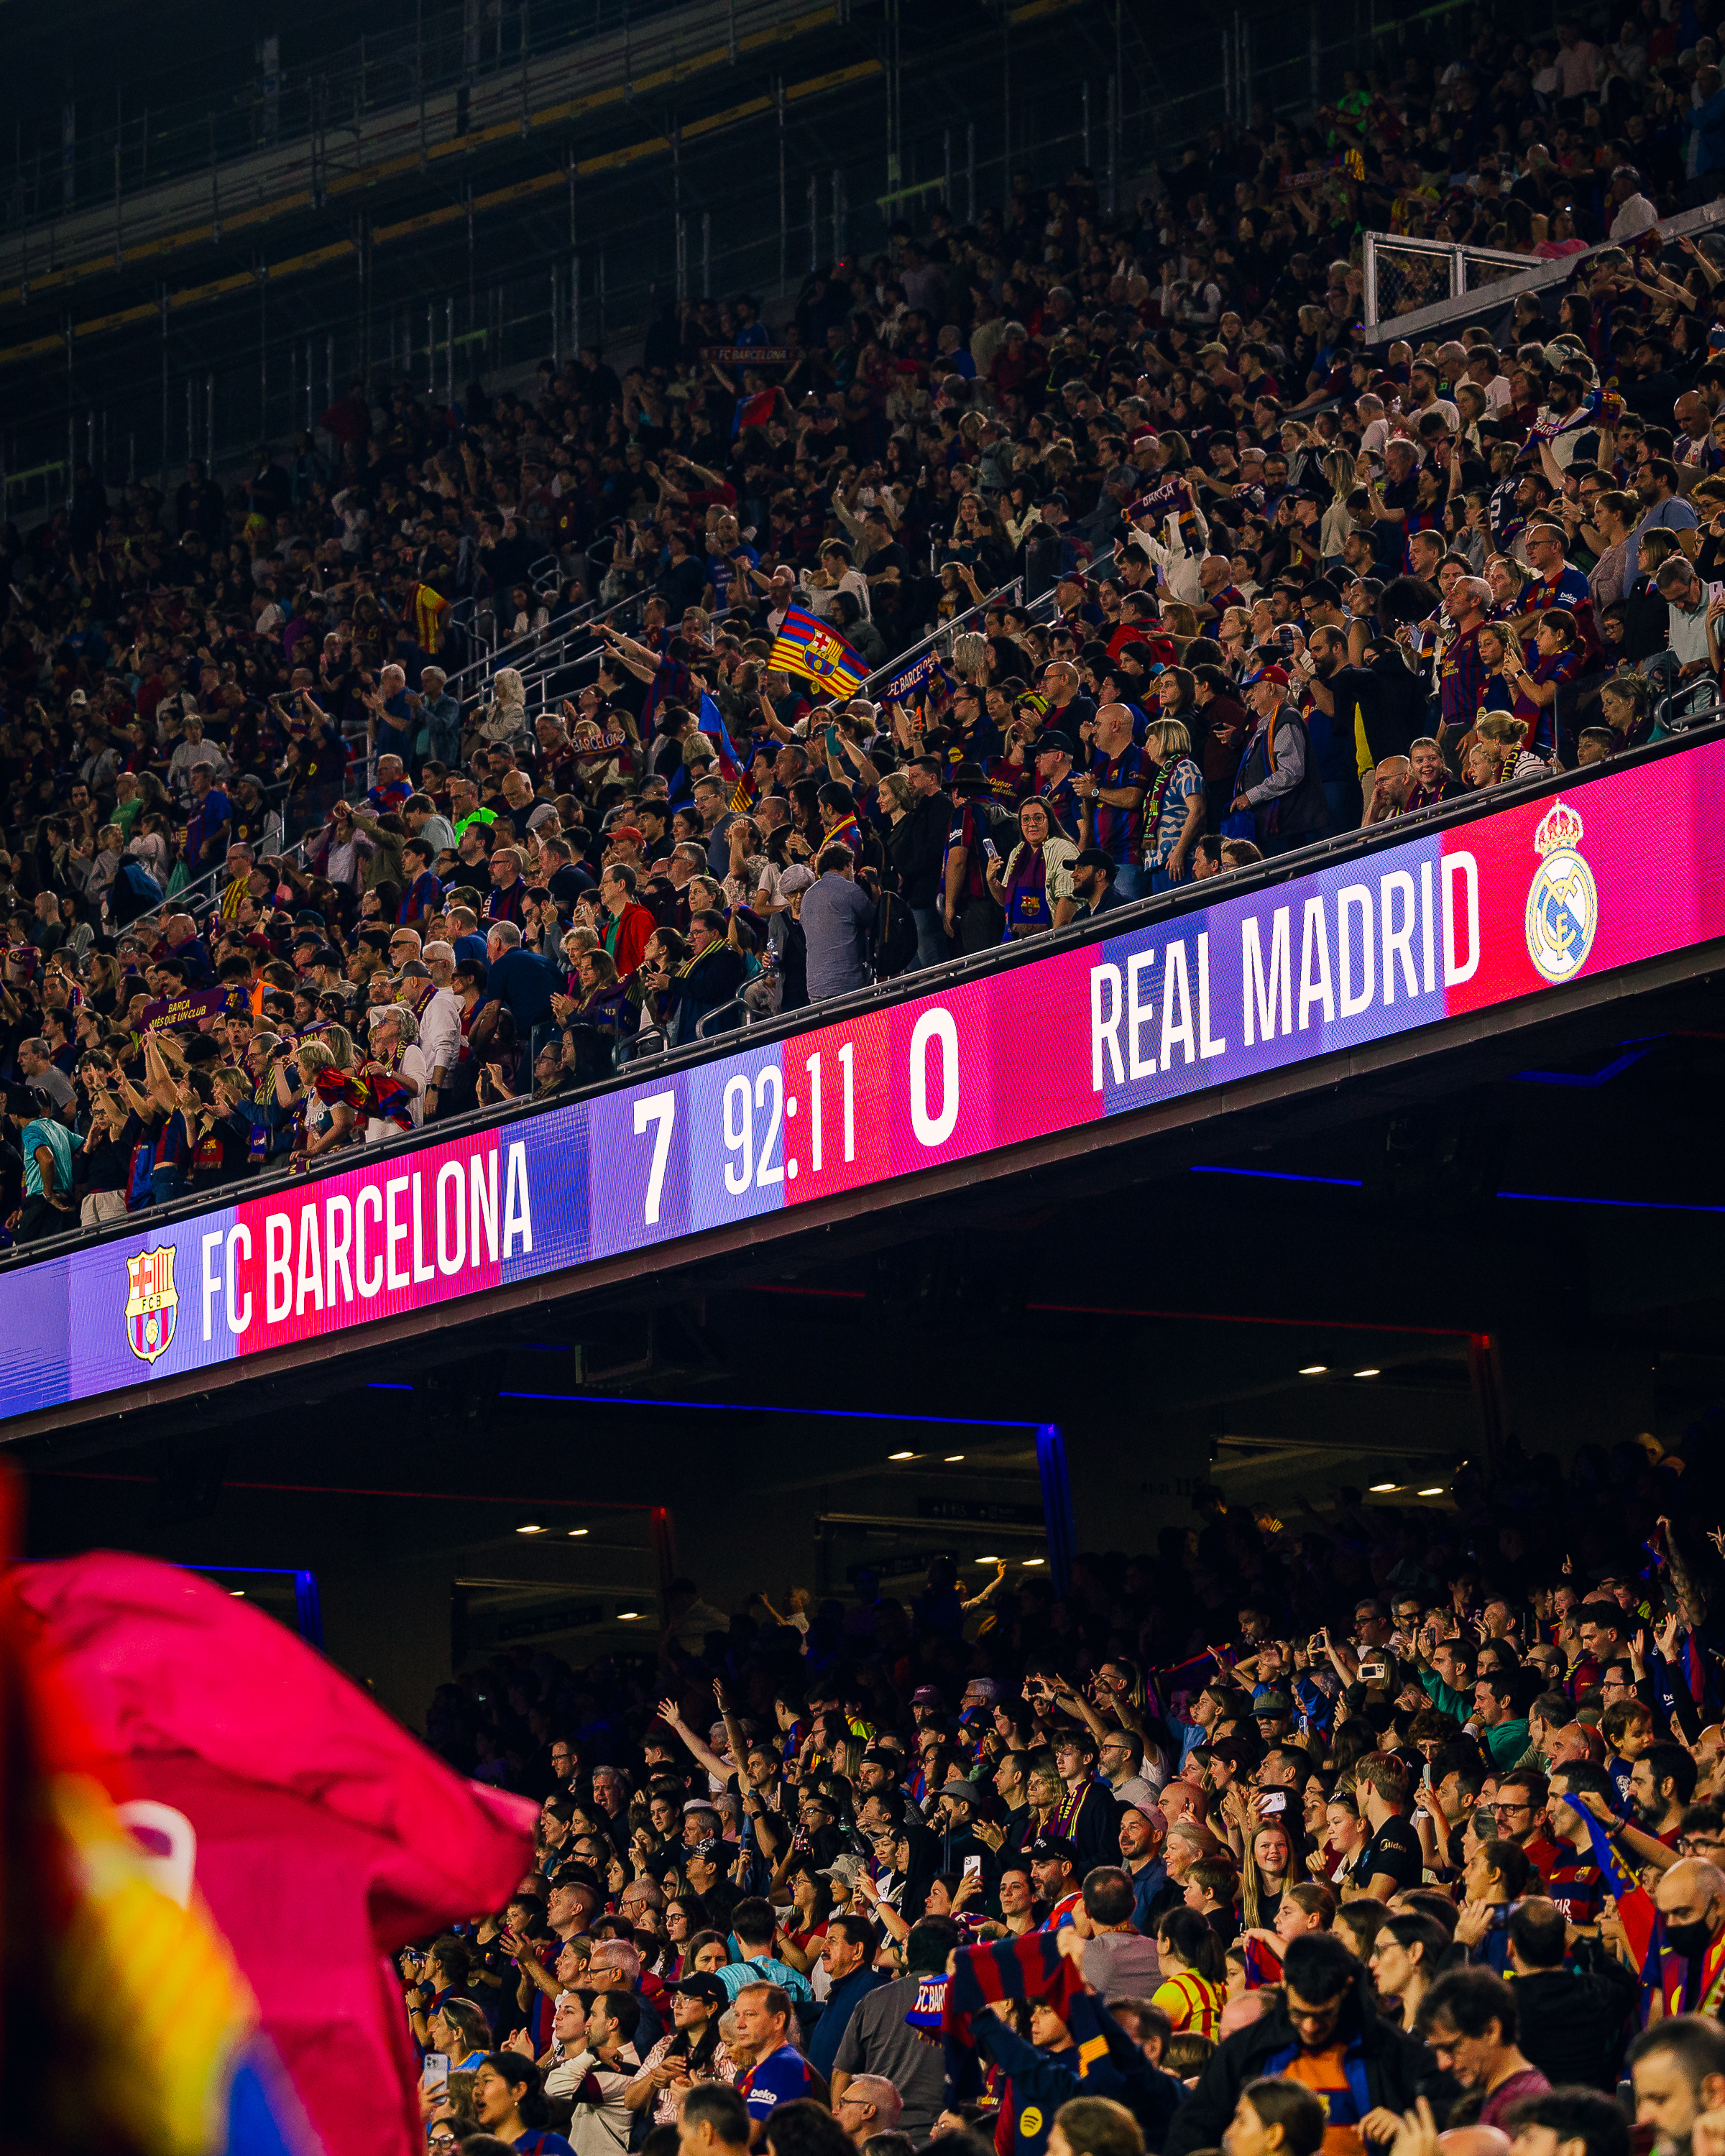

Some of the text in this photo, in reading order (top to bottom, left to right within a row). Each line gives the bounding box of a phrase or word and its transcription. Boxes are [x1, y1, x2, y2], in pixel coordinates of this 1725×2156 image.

[1560, 592, 1578, 603] beko
[815, 649, 829, 660] FCB
[990, 778, 1013, 788] Qatar
[1090, 850, 1481, 1092] REAL MADRID
[164, 1013, 177, 1026] QUE
[178, 1010, 188, 1021] UN
[188, 1005, 207, 1018] CLUB
[168, 999, 190, 1013] BARÇA
[909, 1008, 960, 1147] 0
[721, 1041, 855, 1196] 92:11
[633, 1089, 676, 1226] 7
[202, 1141, 533, 1342] FC BARCELONA
[142, 1295, 161, 1310] FCB
[914, 1985, 929, 2012] FC
